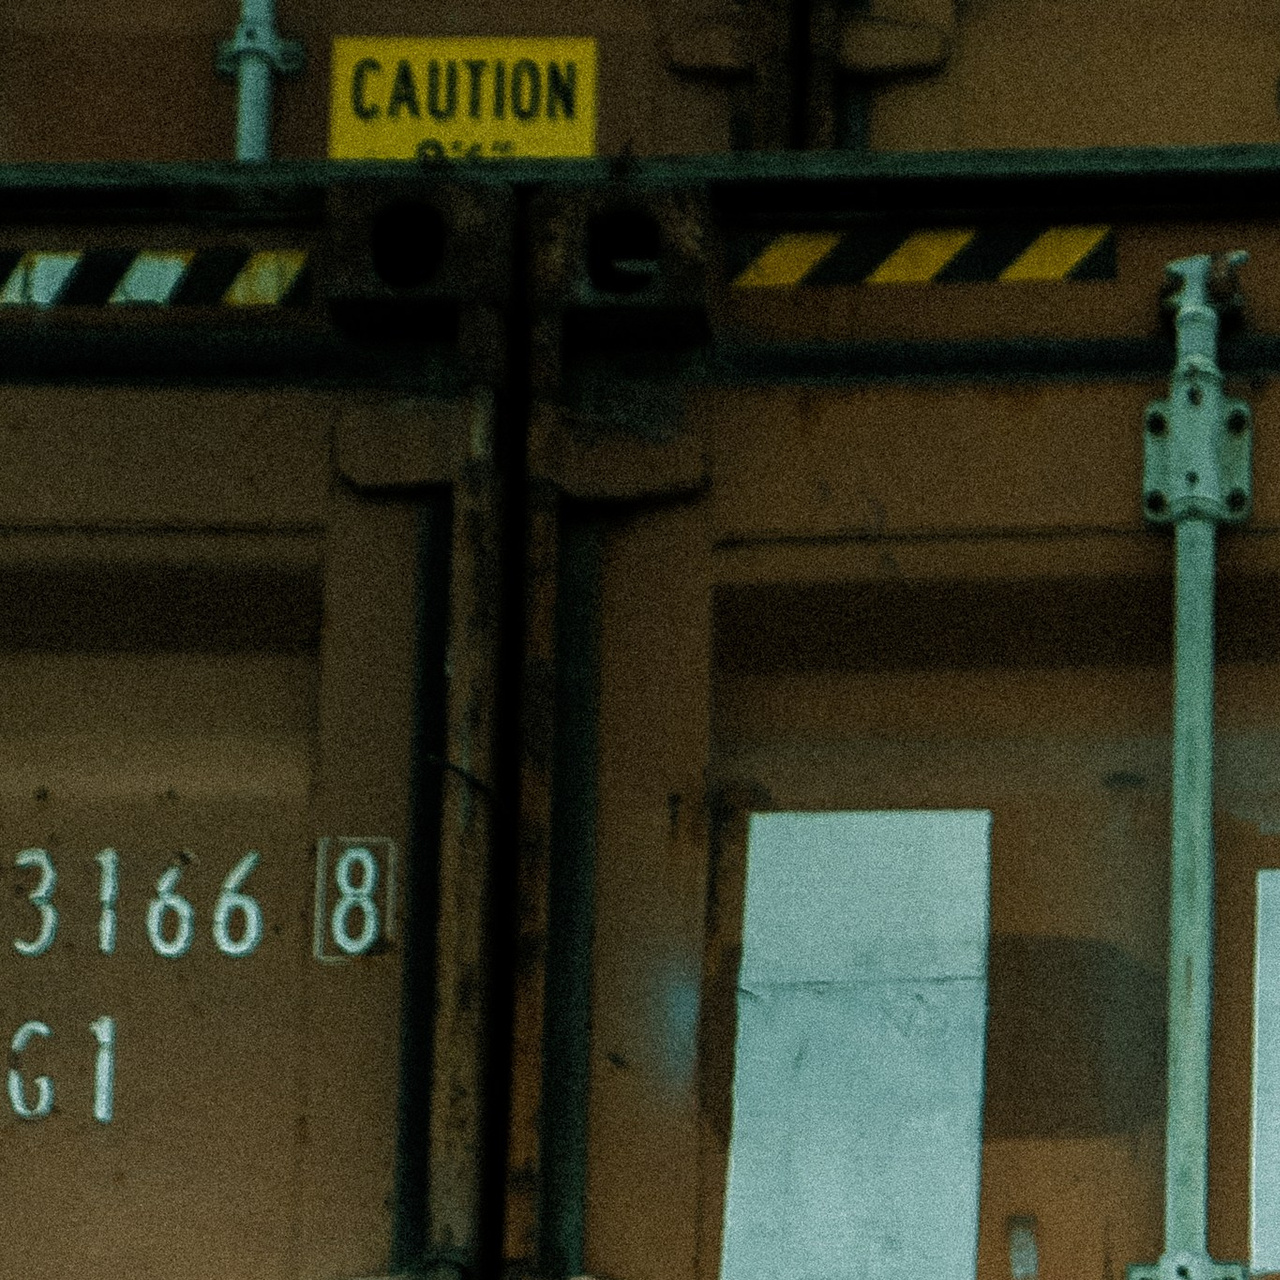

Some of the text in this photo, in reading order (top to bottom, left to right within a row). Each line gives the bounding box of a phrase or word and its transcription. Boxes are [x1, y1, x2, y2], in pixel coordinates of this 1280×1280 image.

[352, 57, 577, 121] CAUTION
[14, 847, 380, 957] 3166 8
[7, 1015, 116, 1123] G1
